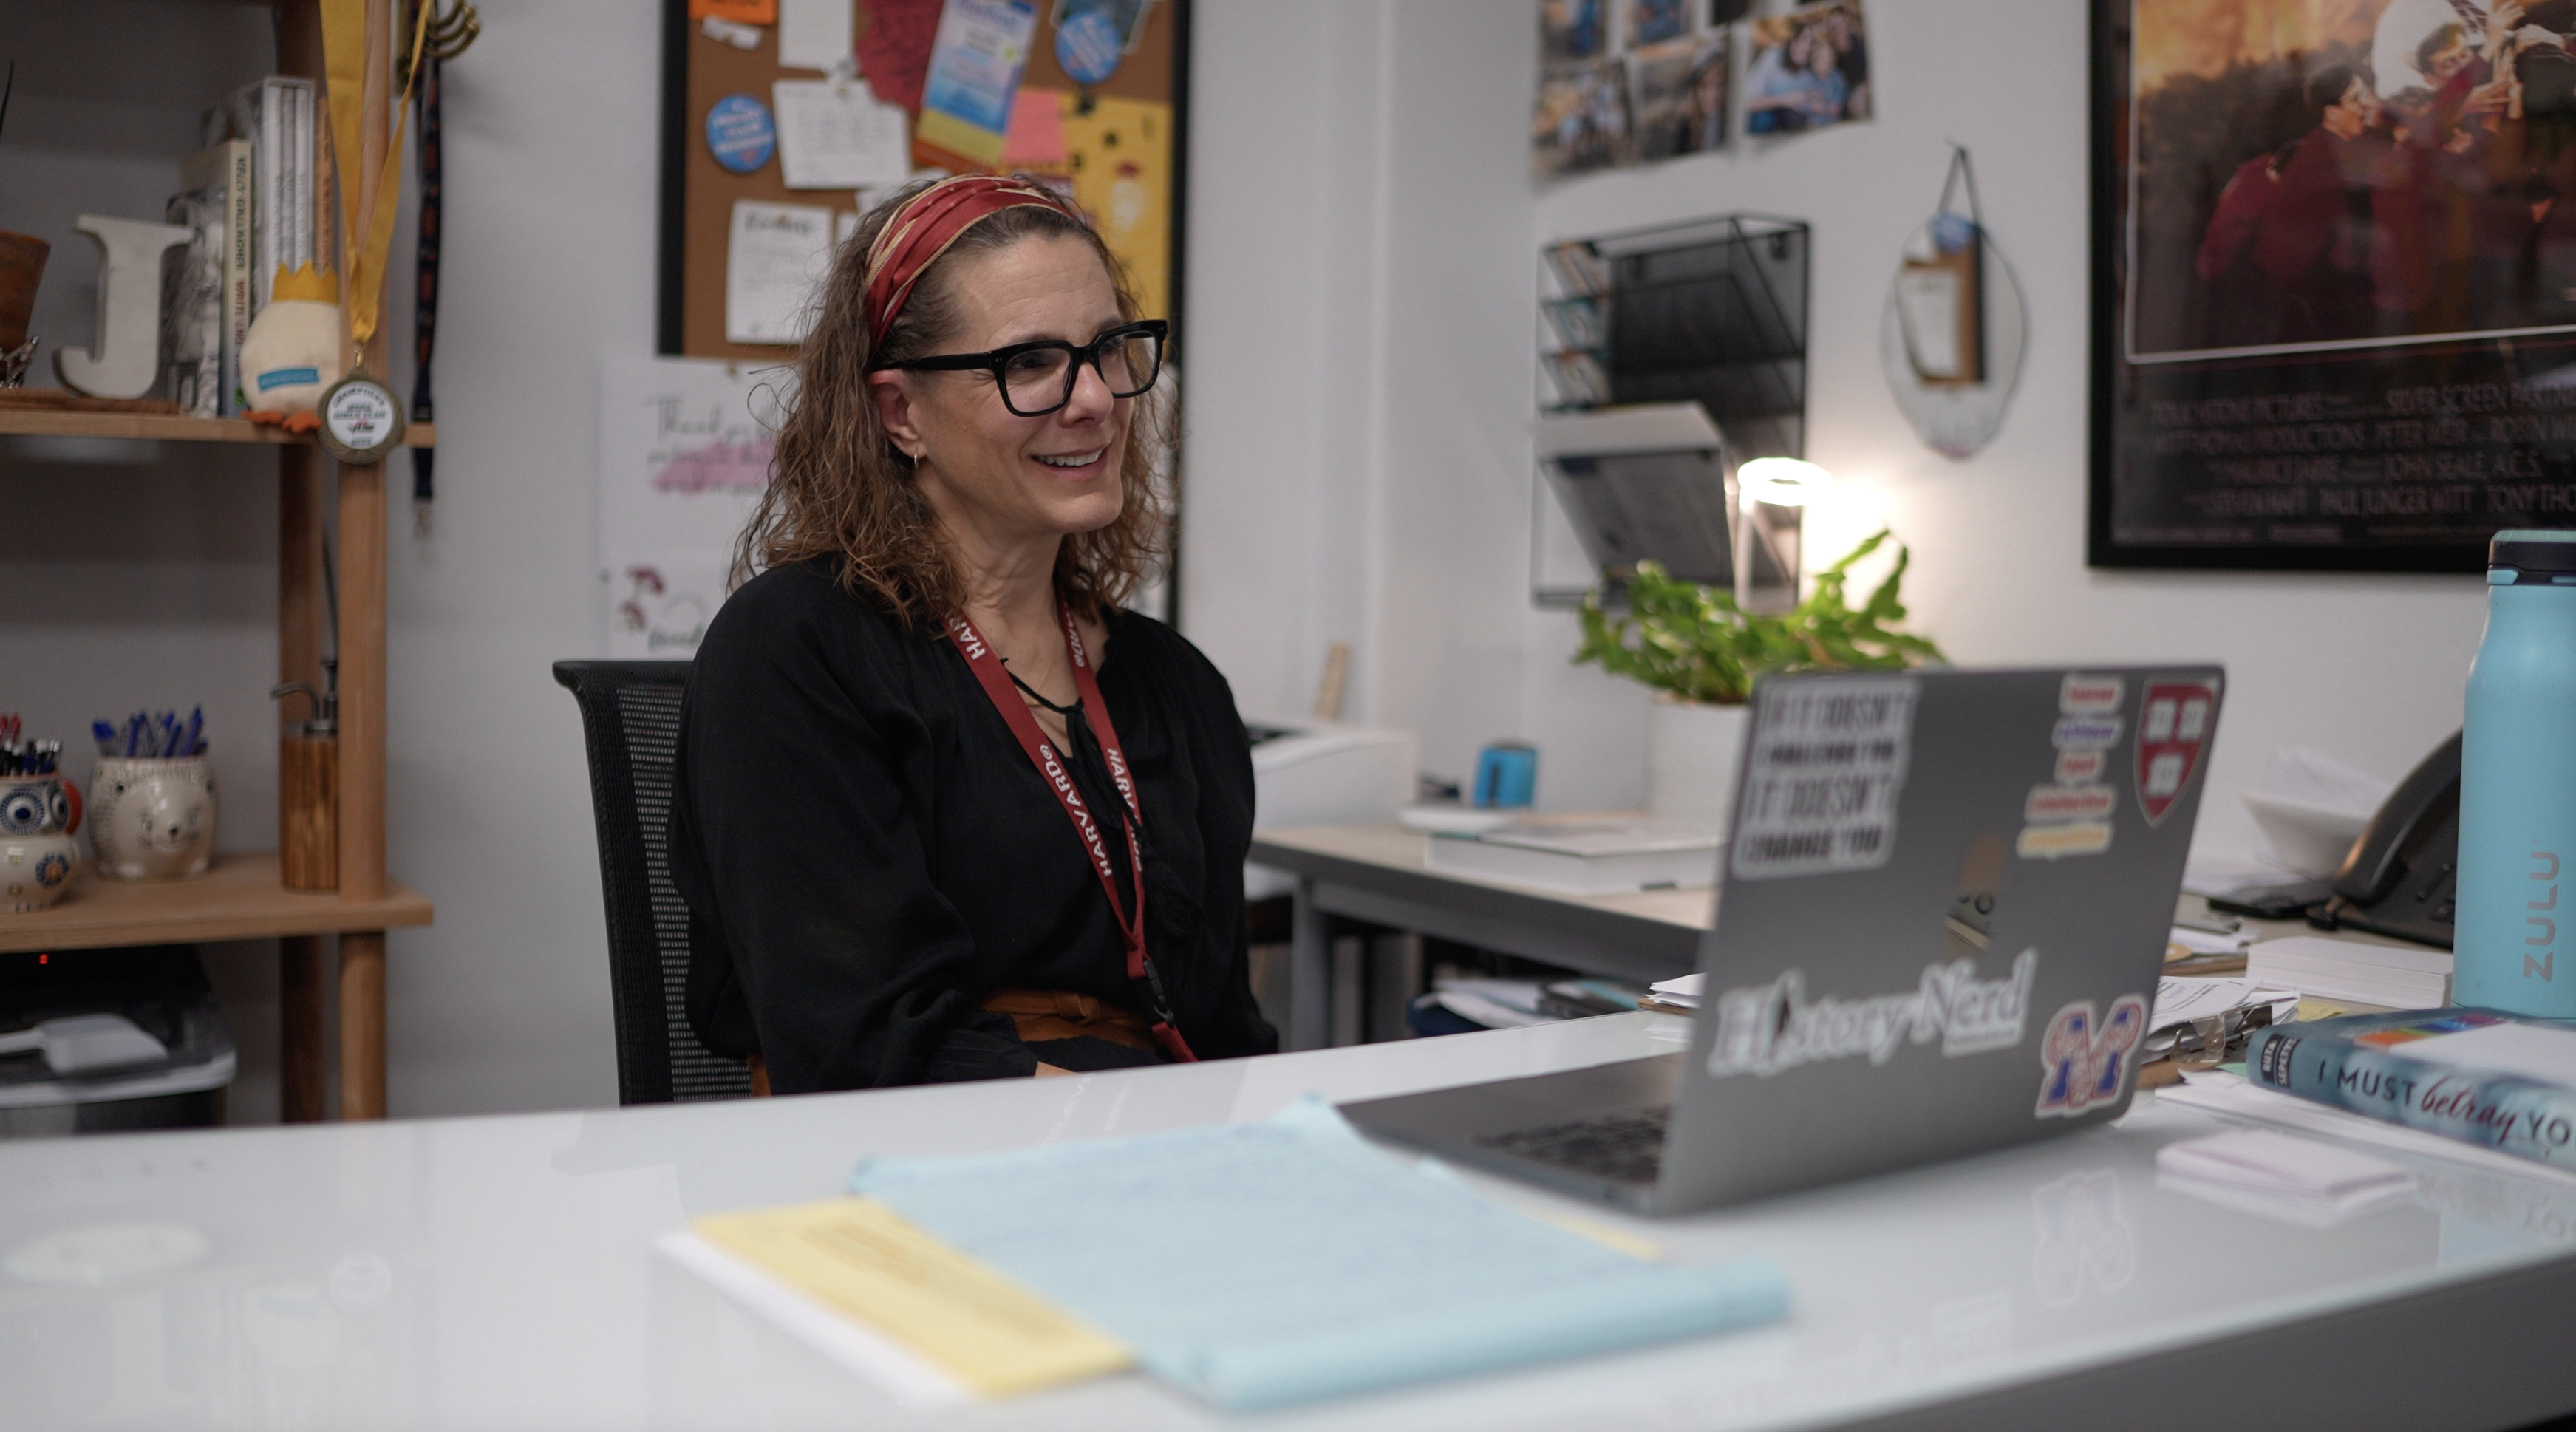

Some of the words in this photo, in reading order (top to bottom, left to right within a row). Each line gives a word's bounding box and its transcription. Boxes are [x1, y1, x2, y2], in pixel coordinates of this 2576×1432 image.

[235, 156, 247, 194] KELLY
[234, 197, 246, 272] GALLAGHER
[234, 279, 245, 316] WRITE
[2387, 386, 2438, 416] SILVER
[2440, 383, 2508, 413] SCREEN
[2383, 452, 2433, 483] JOHN
[2320, 486, 2358, 516] PAUL
[2485, 484, 2537, 514] TONY
[1858, 737, 1895, 762] YOU
[1782, 772, 1892, 819] DOESN'T
[1739, 827, 1834, 863] CHANGE
[1838, 823, 1882, 855] YOU
[2523, 851, 2560, 983] ZULU
[1917, 961, 2029, 1036] Nerd
[2262, 1039, 2278, 1073] RUTA
[2318, 1058, 2326, 1085] I
[2337, 1066, 2418, 1106] MUST
[2419, 1074, 2518, 1147] betray
[2527, 1108, 2576, 1147] YO
